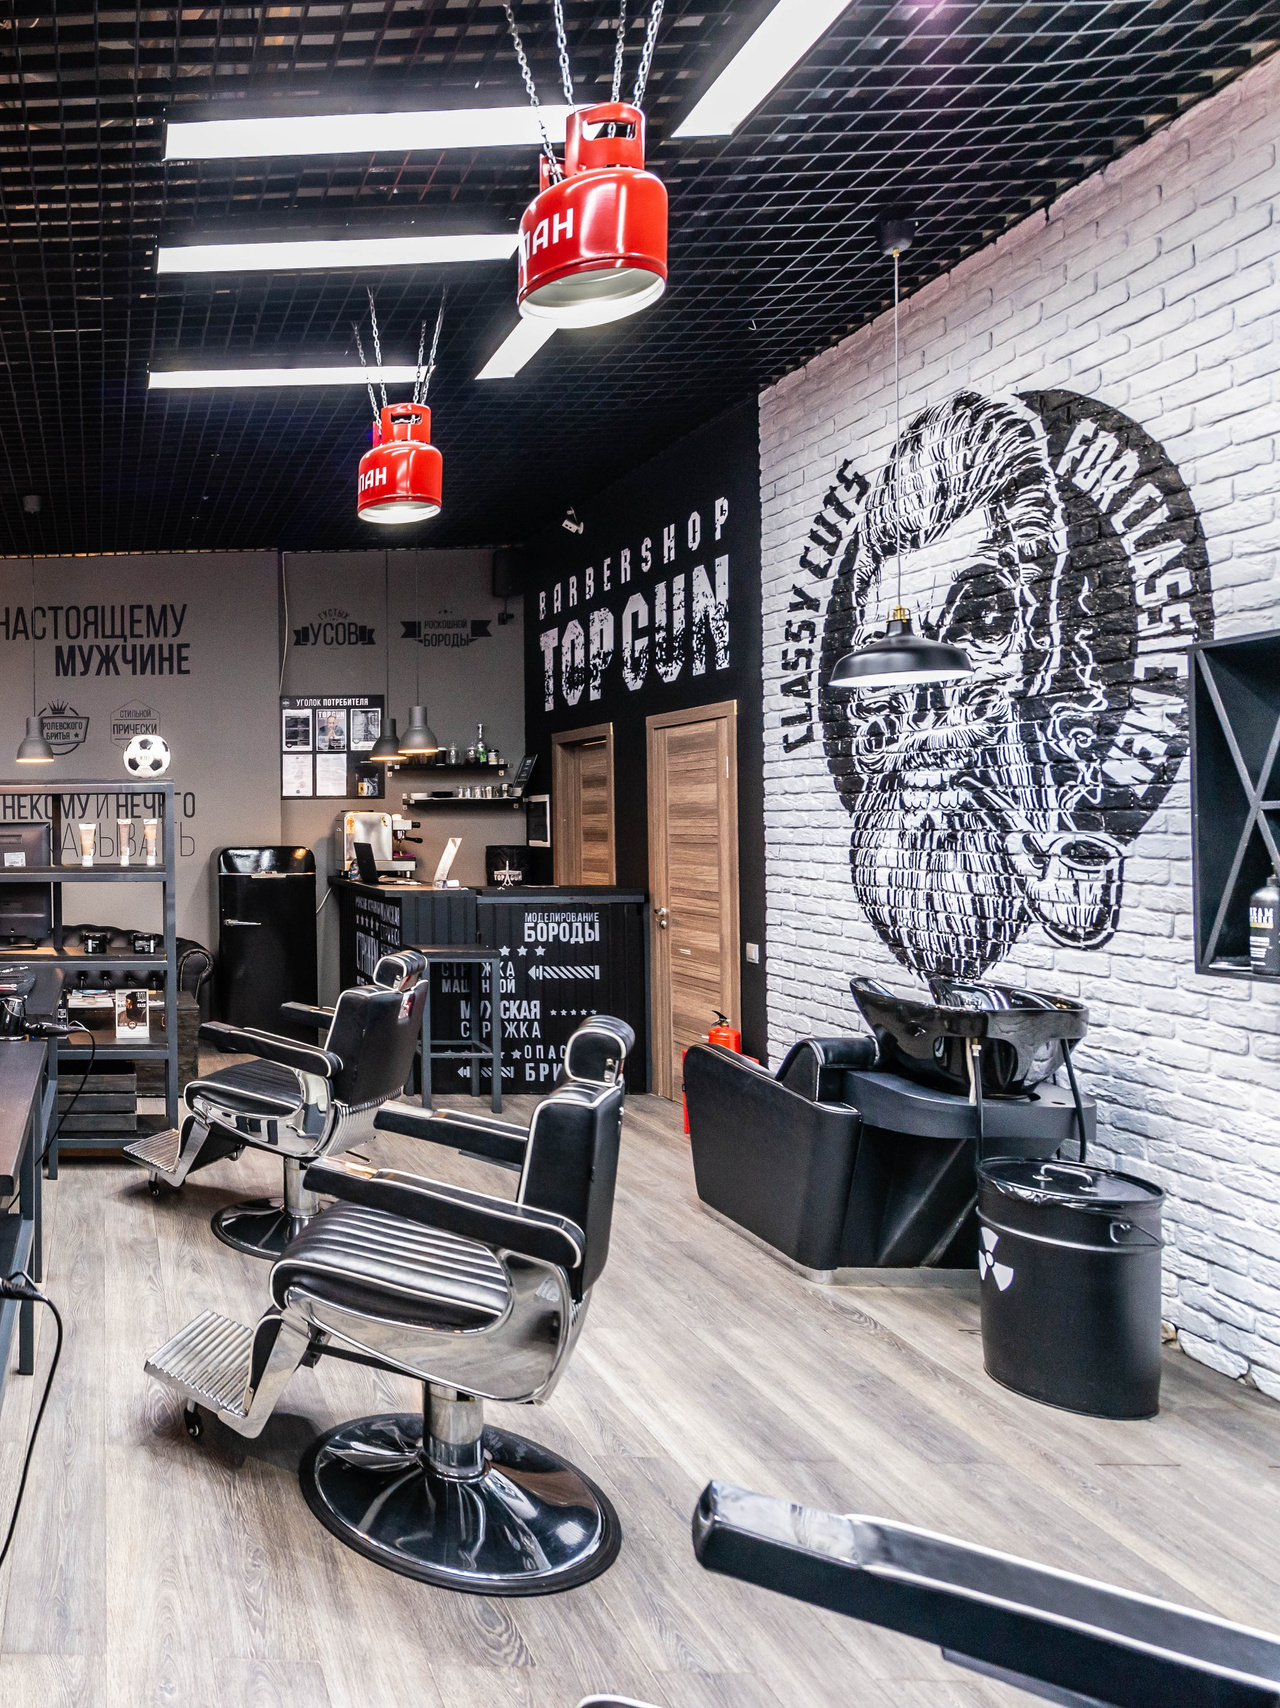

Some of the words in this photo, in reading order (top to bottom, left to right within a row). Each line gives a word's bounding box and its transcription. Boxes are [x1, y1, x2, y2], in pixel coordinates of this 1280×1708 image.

[1055, 417, 1142, 514] FOR
[800, 458, 870, 579] CUTS
[539, 496, 729, 621] BARBERSHOP
[318, 608, 350, 620] ГУСТЫХ
[424, 619, 468, 629] РОСКОШНОЙ
[310, 622, 360, 646] УСОВ
[423, 633, 469, 648] БОРОДЫ
[55, 643, 191, 676] МУЖЧИНЕ
[781, 584, 821, 753] CLASSY
[296, 698, 321, 707] УГОЛОК
[322, 697, 369, 706] ПОТРЕБИТЕЛЯ
[119, 708, 151, 718] СТИЛЬНОЙ
[43, 721, 83, 731] РОЛЕВСКОГО
[112, 723, 157, 735] ПРИЧЕСКИ
[46, 732, 71, 740] БРИТЬЯ
[524, 912, 599, 923] МОДЕЛИРОВАНИЕ
[524, 922, 600, 944] БОРОДЫ
[461, 1021, 541, 1039] СРЖКА
